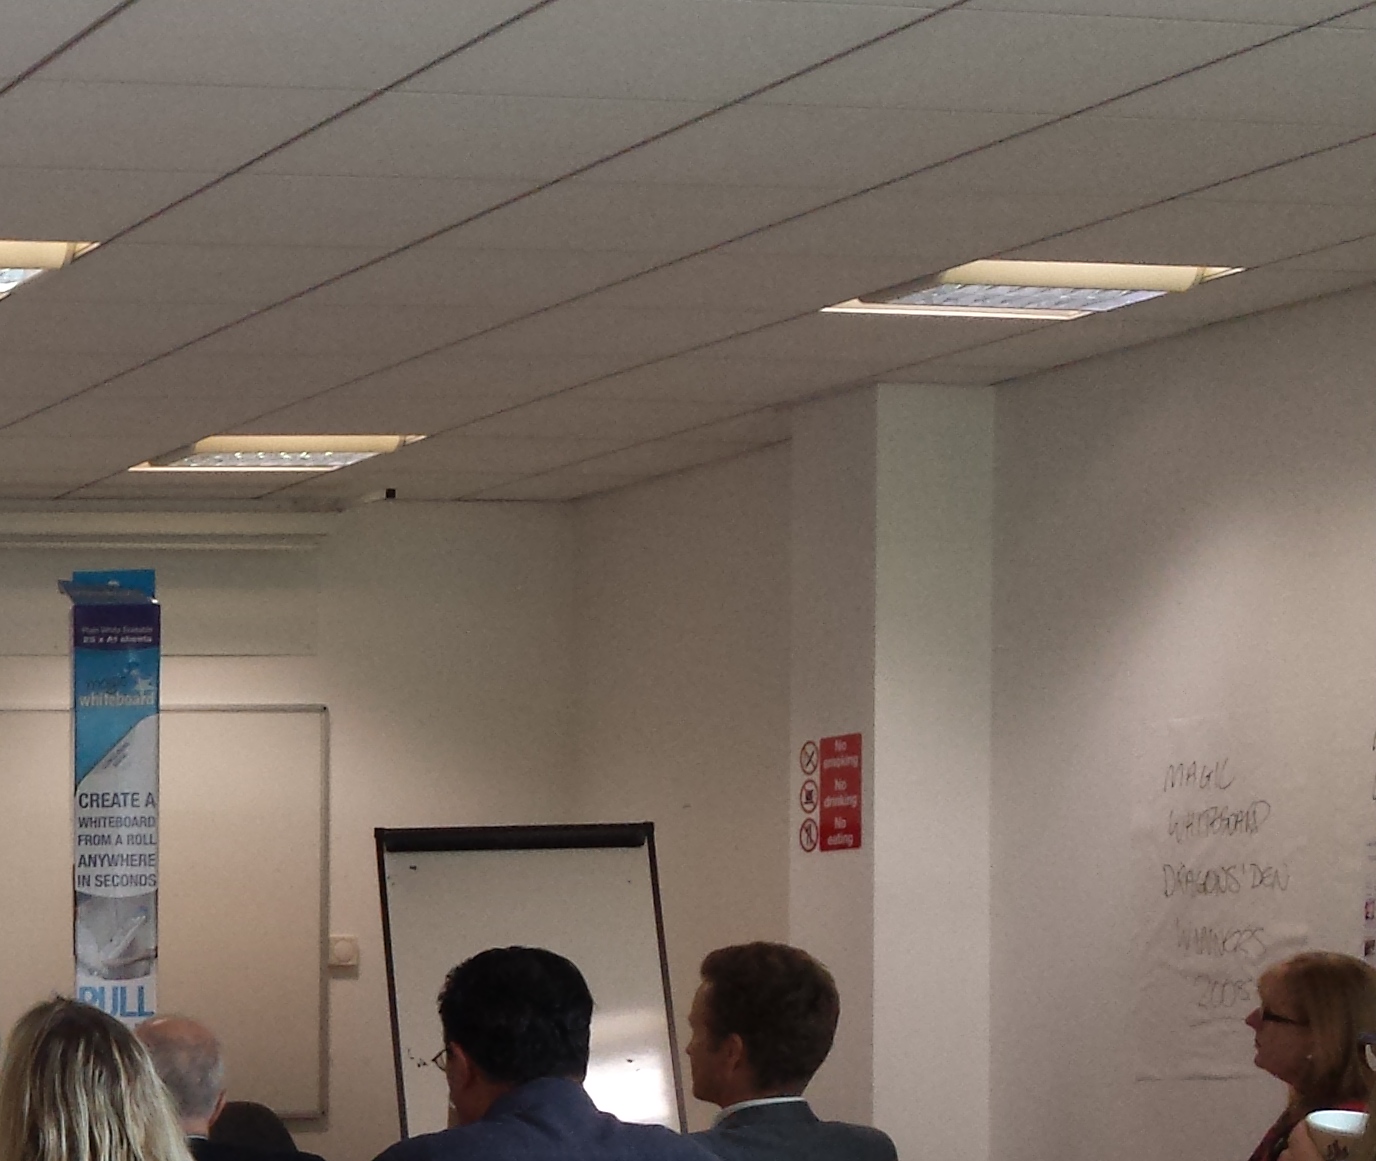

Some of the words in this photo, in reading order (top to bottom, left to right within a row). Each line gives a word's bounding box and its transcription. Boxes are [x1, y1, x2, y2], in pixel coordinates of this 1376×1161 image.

[79, 691, 155, 706] whiteboard
[834, 740, 847, 751] No
[834, 778, 847, 791] No
[78, 792, 141, 808] CREATE
[145, 792, 156, 808] A
[824, 795, 858, 808] drinking
[78, 816, 156, 829] WHITEBOARD
[834, 816, 847, 829] No
[77, 834, 112, 846] FROM
[114, 833, 123, 845] A
[126, 833, 157, 845] ROLL
[827, 833, 854, 847] eating
[77, 853, 156, 868] ANYWHERE
[77, 874, 91, 888] IN
[94, 873, 157, 888] SECONDS
[1250, 861, 1290, 892] DEN
[79, 985, 155, 1018] PULL
